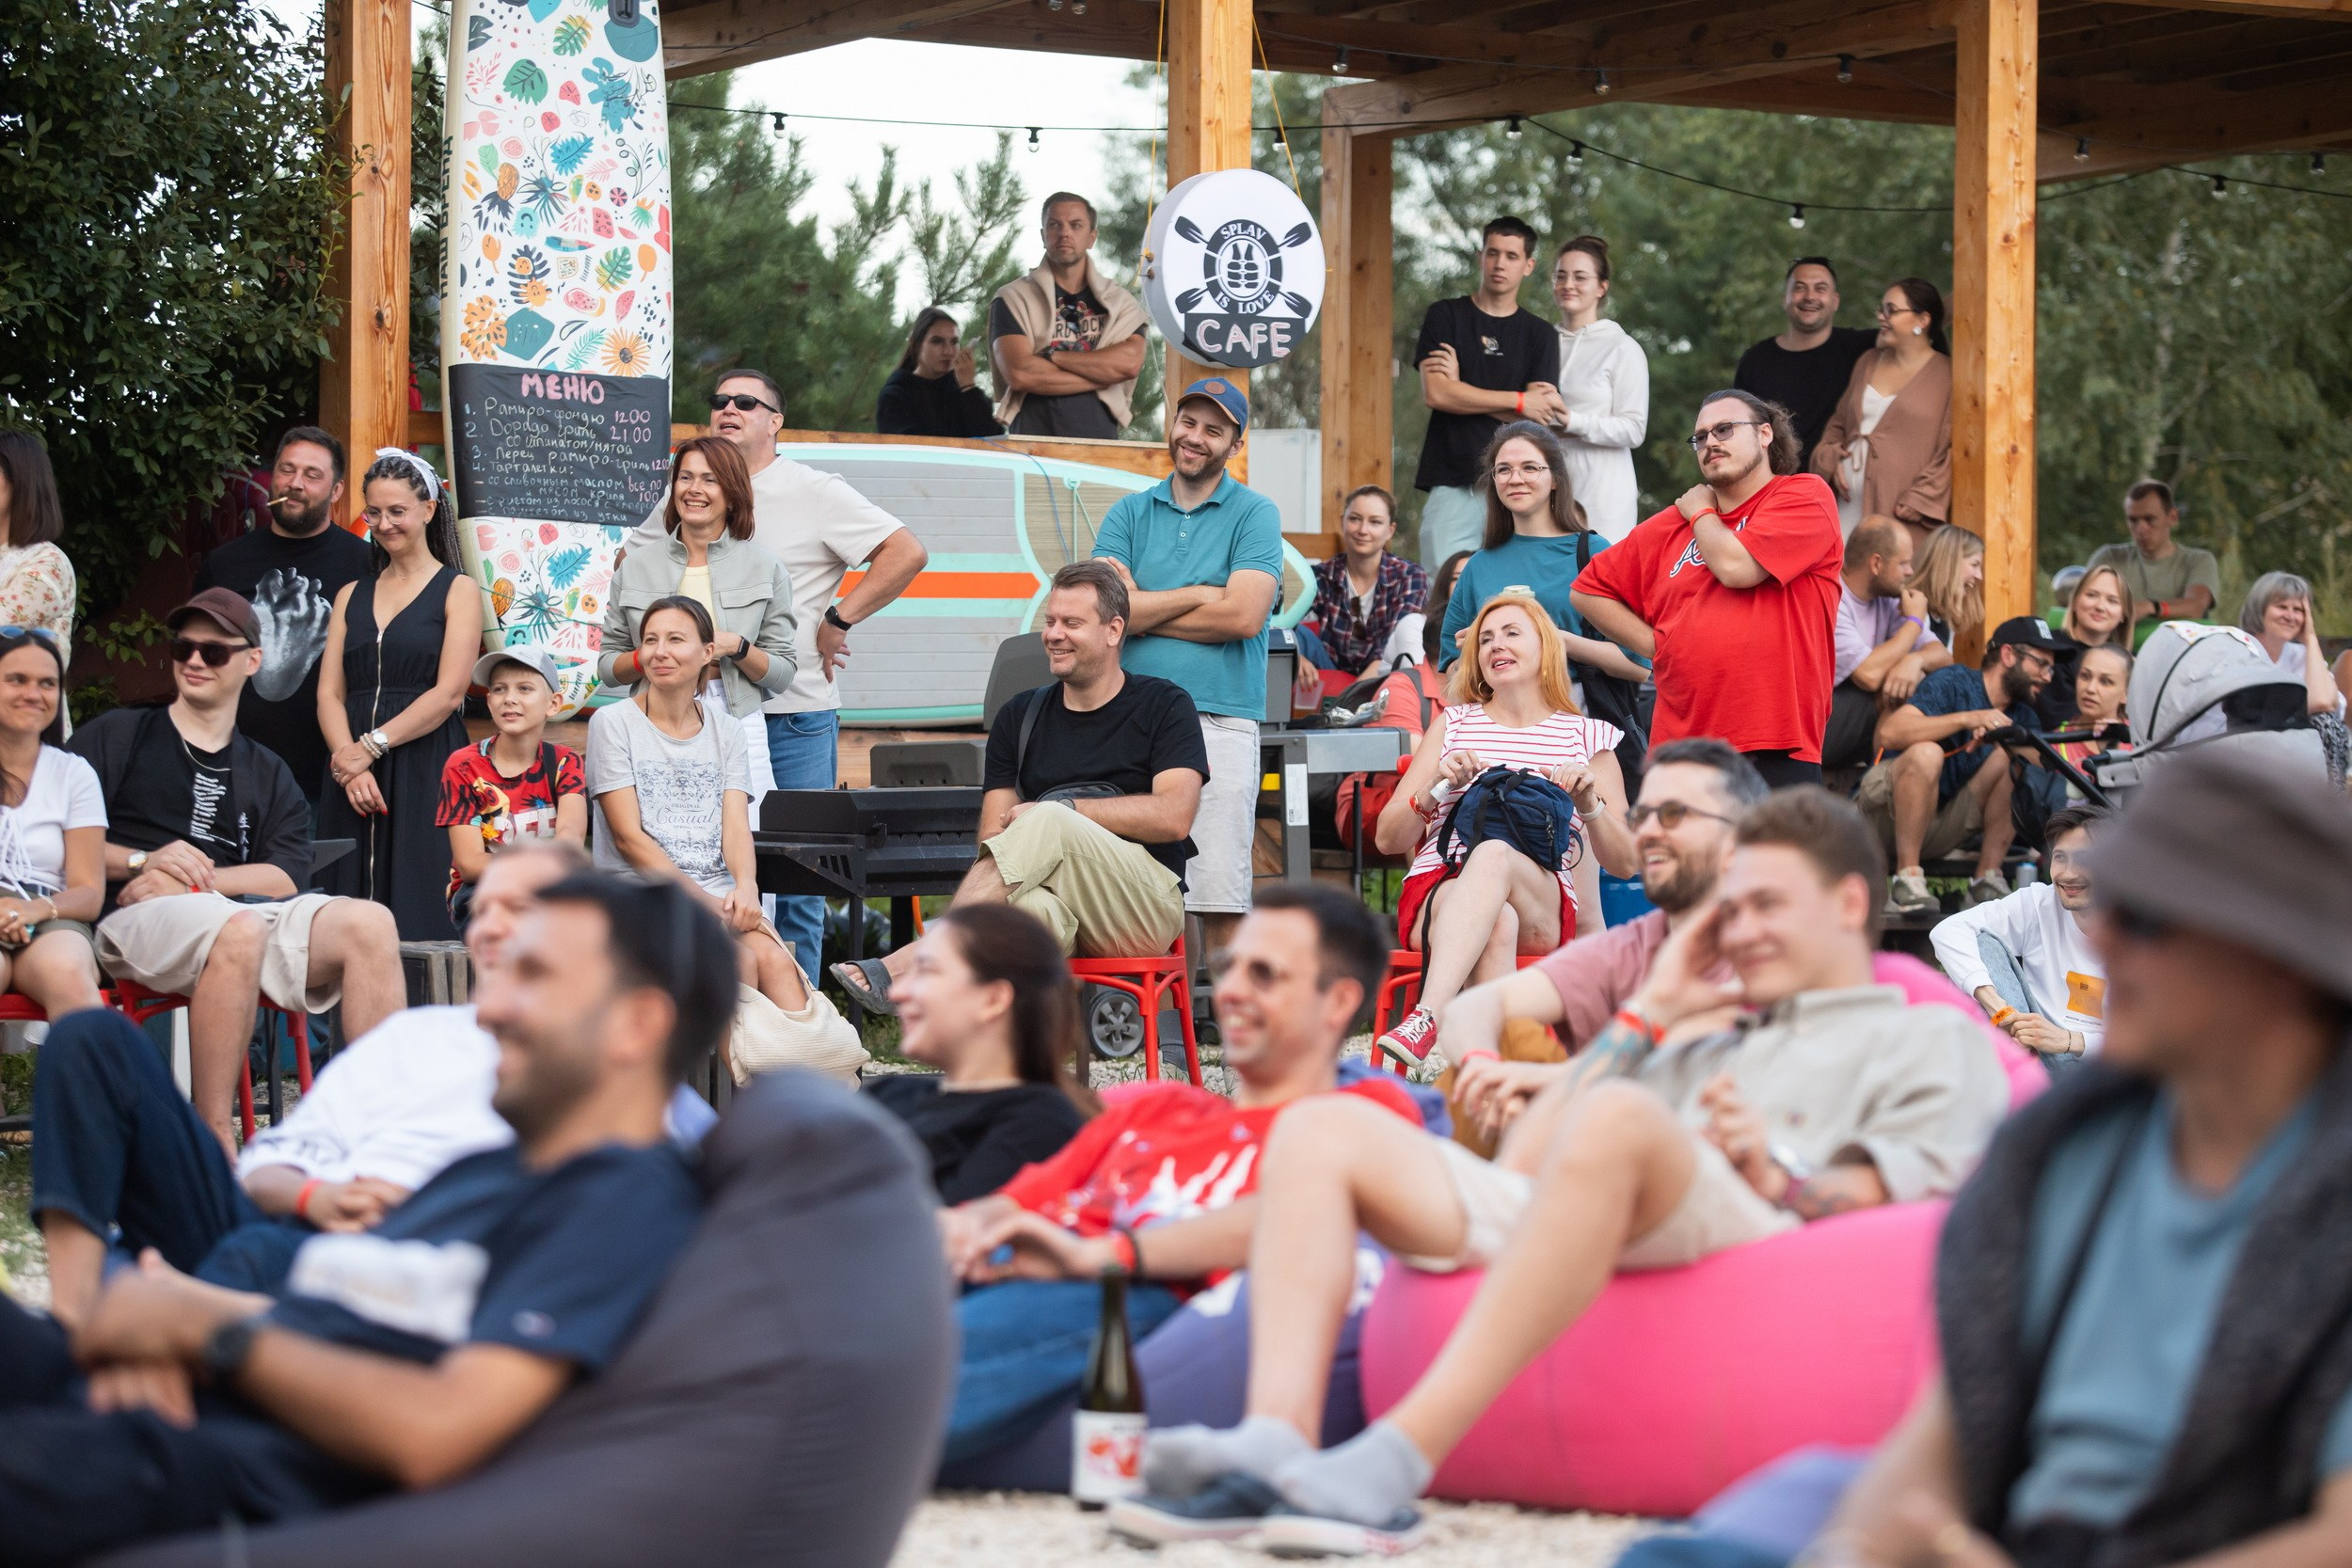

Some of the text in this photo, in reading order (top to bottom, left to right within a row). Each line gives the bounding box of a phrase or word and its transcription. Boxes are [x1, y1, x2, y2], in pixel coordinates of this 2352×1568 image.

[1220, 222, 1267, 241] SPLAV
[1215, 290, 1275, 314] IS LOVE
[1196, 319, 1292, 359] CAFE
[521, 372, 605, 404] МЕНЮ
[614, 408, 651, 424] 1200
[464, 420, 484, 438] 2.
[610, 425, 652, 444] 2100
[496, 447, 534, 463] Перец
[639, 490, 660, 503] 100
[656, 804, 716, 824] Casual
